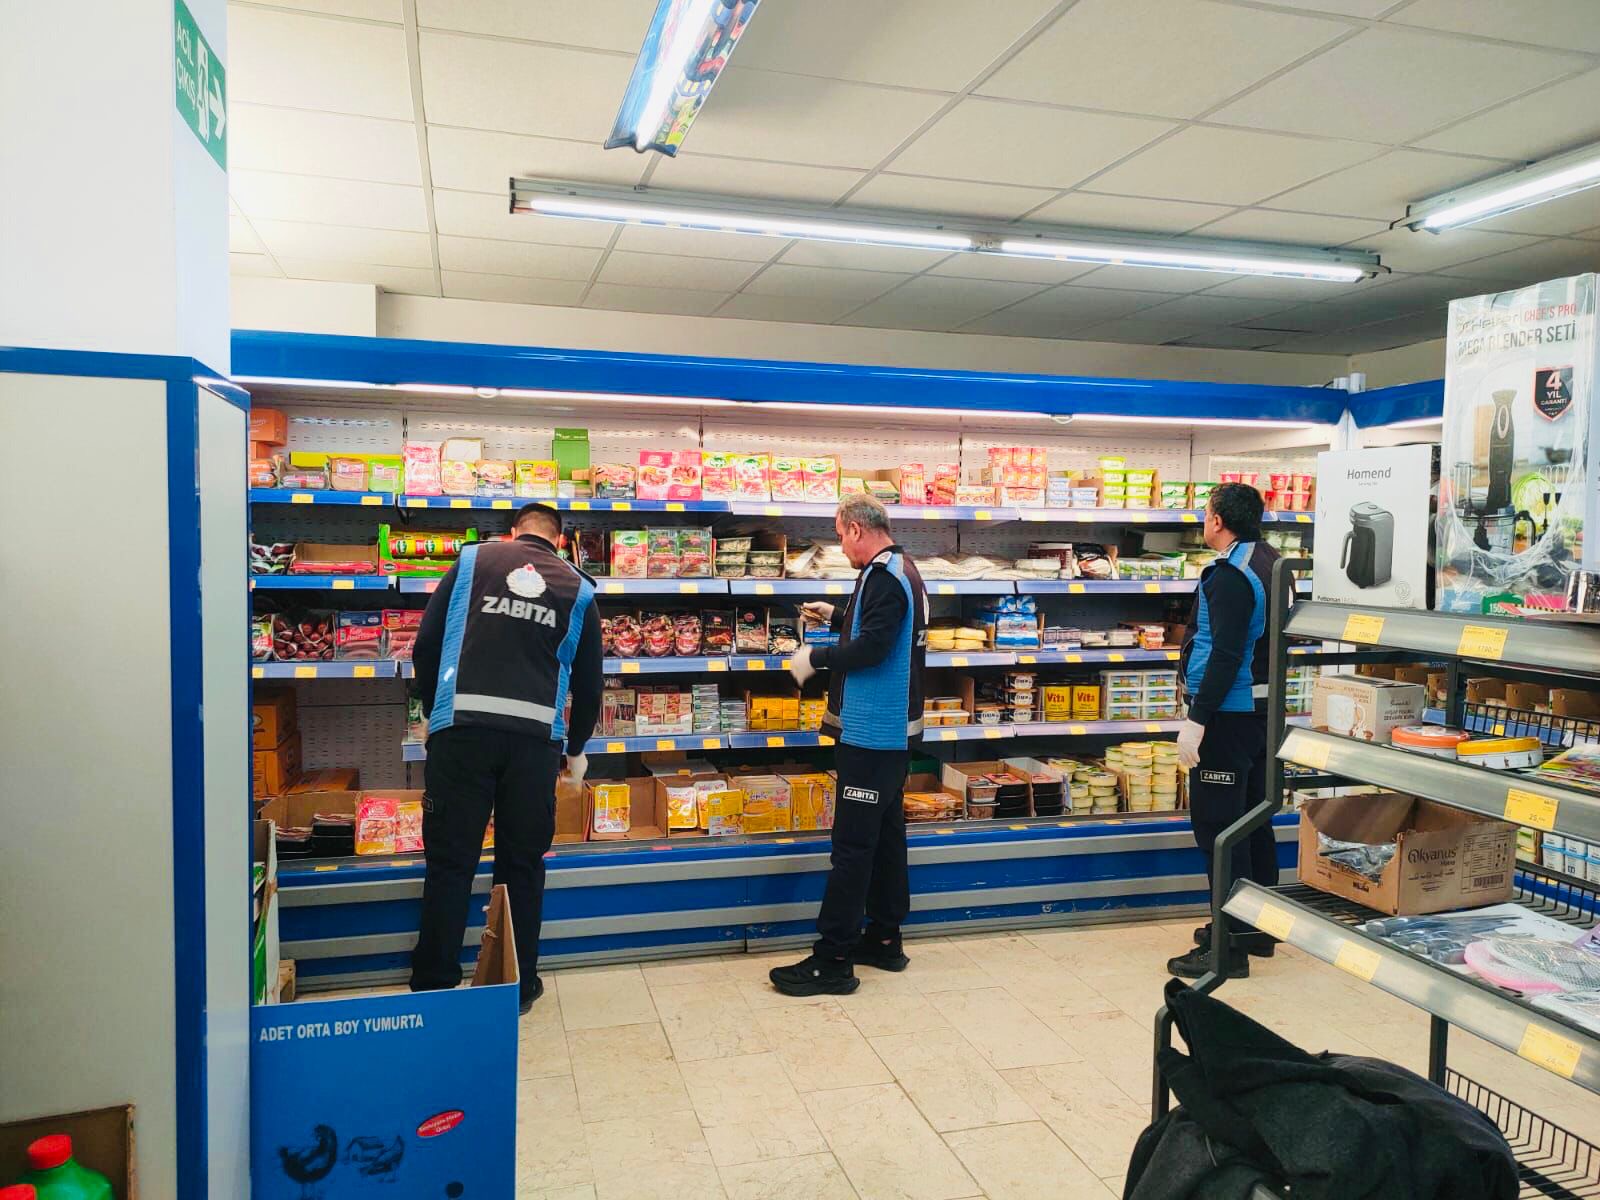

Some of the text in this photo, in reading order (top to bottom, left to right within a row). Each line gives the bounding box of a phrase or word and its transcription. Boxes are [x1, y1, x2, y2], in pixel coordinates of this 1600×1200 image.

[1524, 303, 1576, 322] CHEF'S PRO
[1488, 328, 1542, 351] BLENDER
[1546, 319, 1577, 343] SETİ
[1545, 370, 1562, 391] 4
[1546, 390, 1562, 399] YIL
[1346, 466, 1392, 480] Homend
[480, 595, 557, 629] ZABITA
[1203, 772, 1231, 782] ZABITA
[846, 788, 875, 801] ZABITA
[259, 1013, 424, 1042] ADET ORTA BOY YUMURTA
